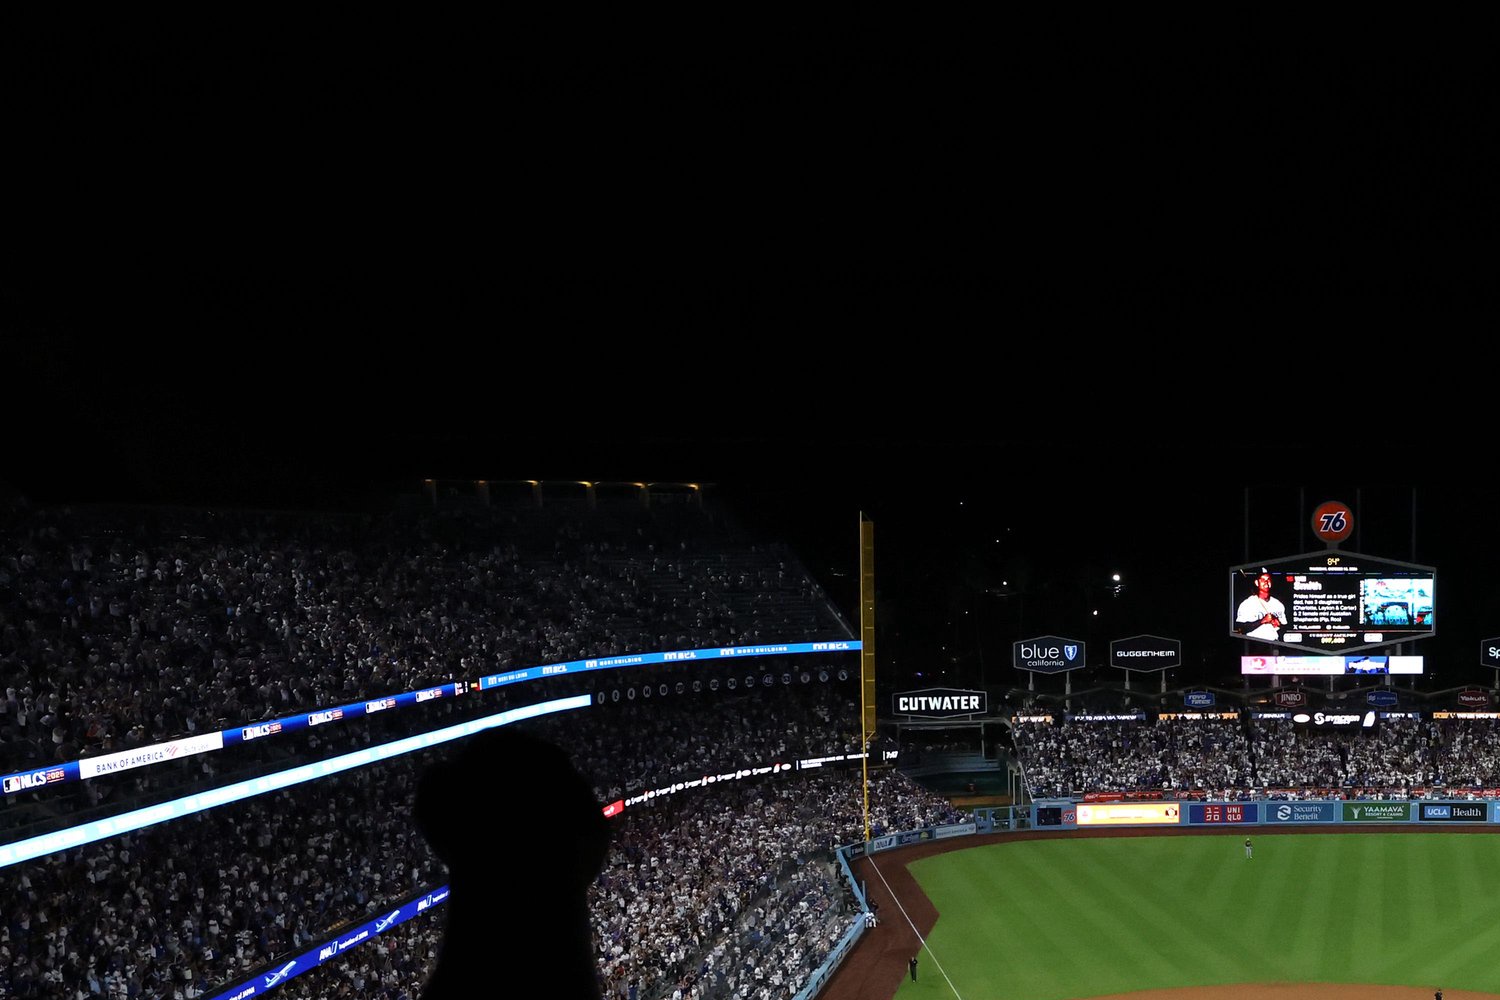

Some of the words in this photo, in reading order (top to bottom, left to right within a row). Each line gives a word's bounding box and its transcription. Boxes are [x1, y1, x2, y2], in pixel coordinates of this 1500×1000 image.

[1320, 512, 1346, 532] 76
[1021, 644, 1060, 660] blue
[1116, 650, 1175, 658] GUGGENHEIM
[1027, 659, 1064, 668] california
[899, 695, 980, 712] CUTWATER
[1281, 694, 1301, 702] JINRO
[96, 760, 118, 773] BANK
[120, 756, 130, 768] OF
[130, 751, 164, 765] AMERICA
[21, 771, 47, 789] NLCS
[1294, 804, 1322, 814] Security
[1427, 808, 1447, 816] UCLA
[1453, 808, 1482, 817] Health
[1063, 812, 1075, 822] 76
[1294, 812, 1319, 821] Benefit
[319, 946, 332, 961] ANA
[243, 986, 255, 998] JAPAN
